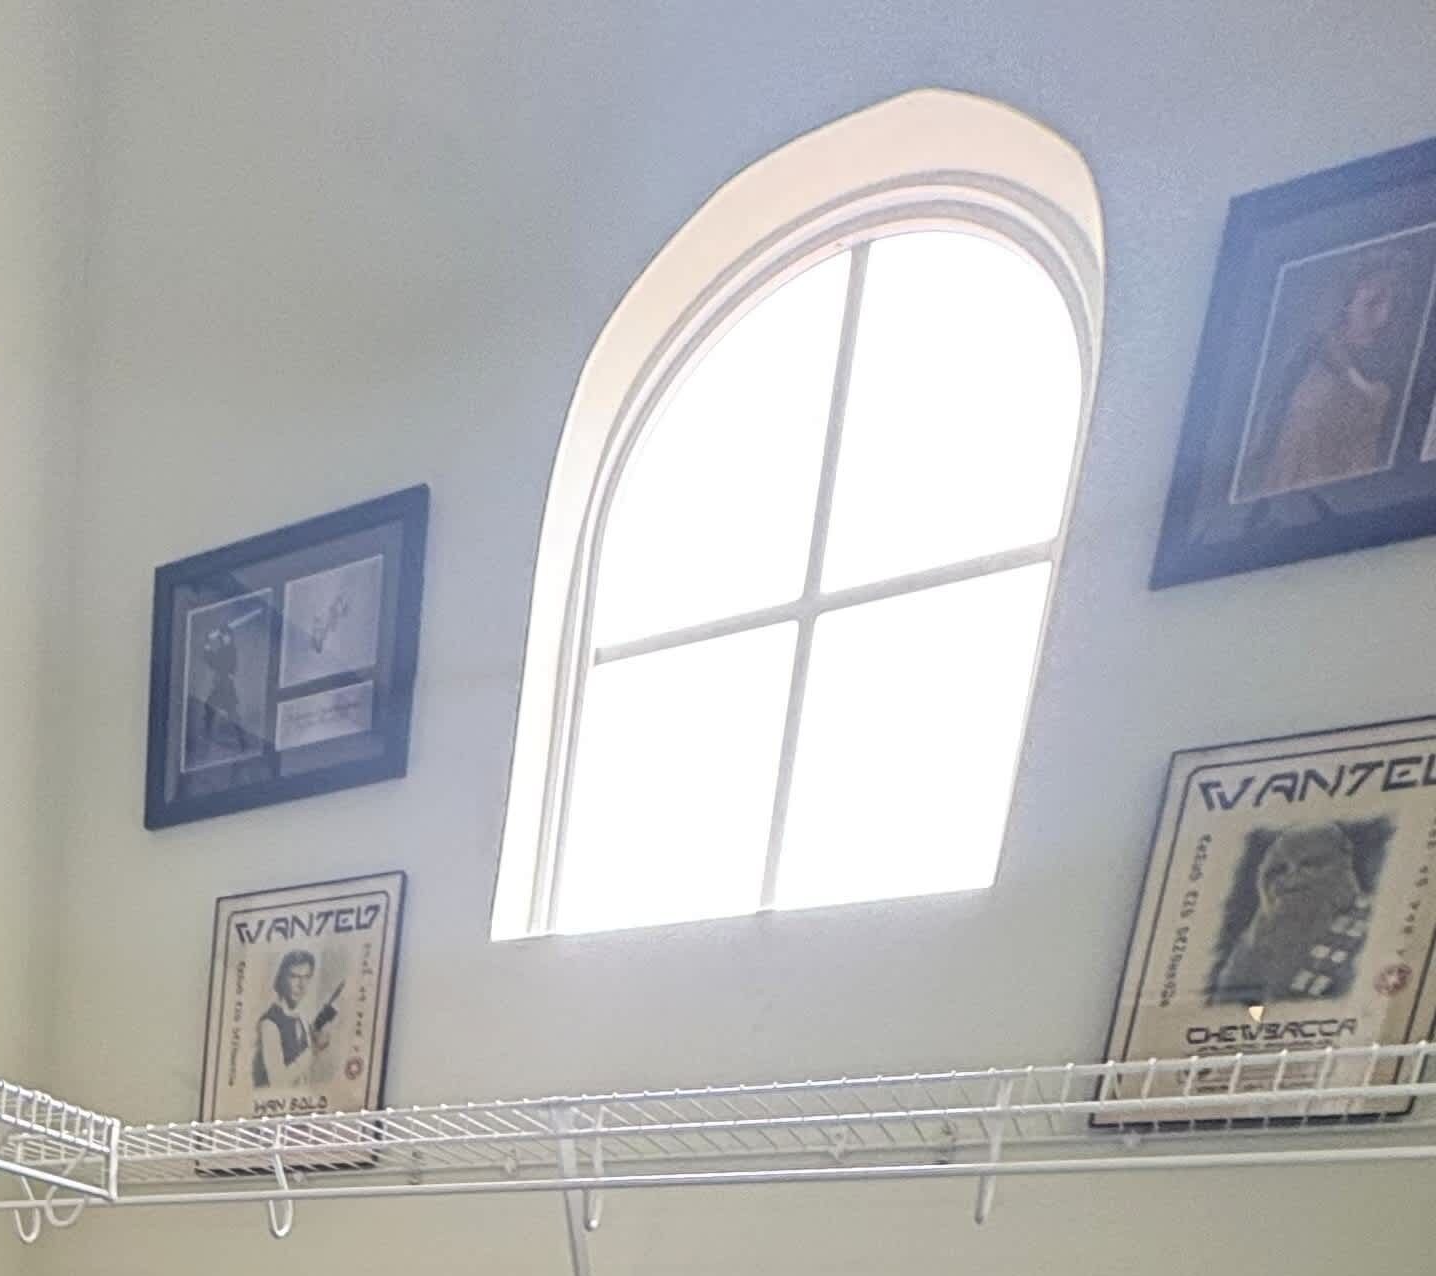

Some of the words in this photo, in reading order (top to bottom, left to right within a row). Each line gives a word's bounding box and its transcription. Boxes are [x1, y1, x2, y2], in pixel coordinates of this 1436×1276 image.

[1198, 753, 1436, 811] WANTE
[235, 903, 381, 945] WANTED
[1186, 1018, 1358, 1045] CHEWBACCA
[253, 1096, 286, 1114] HAN
[289, 1095, 328, 1111] SOLO
